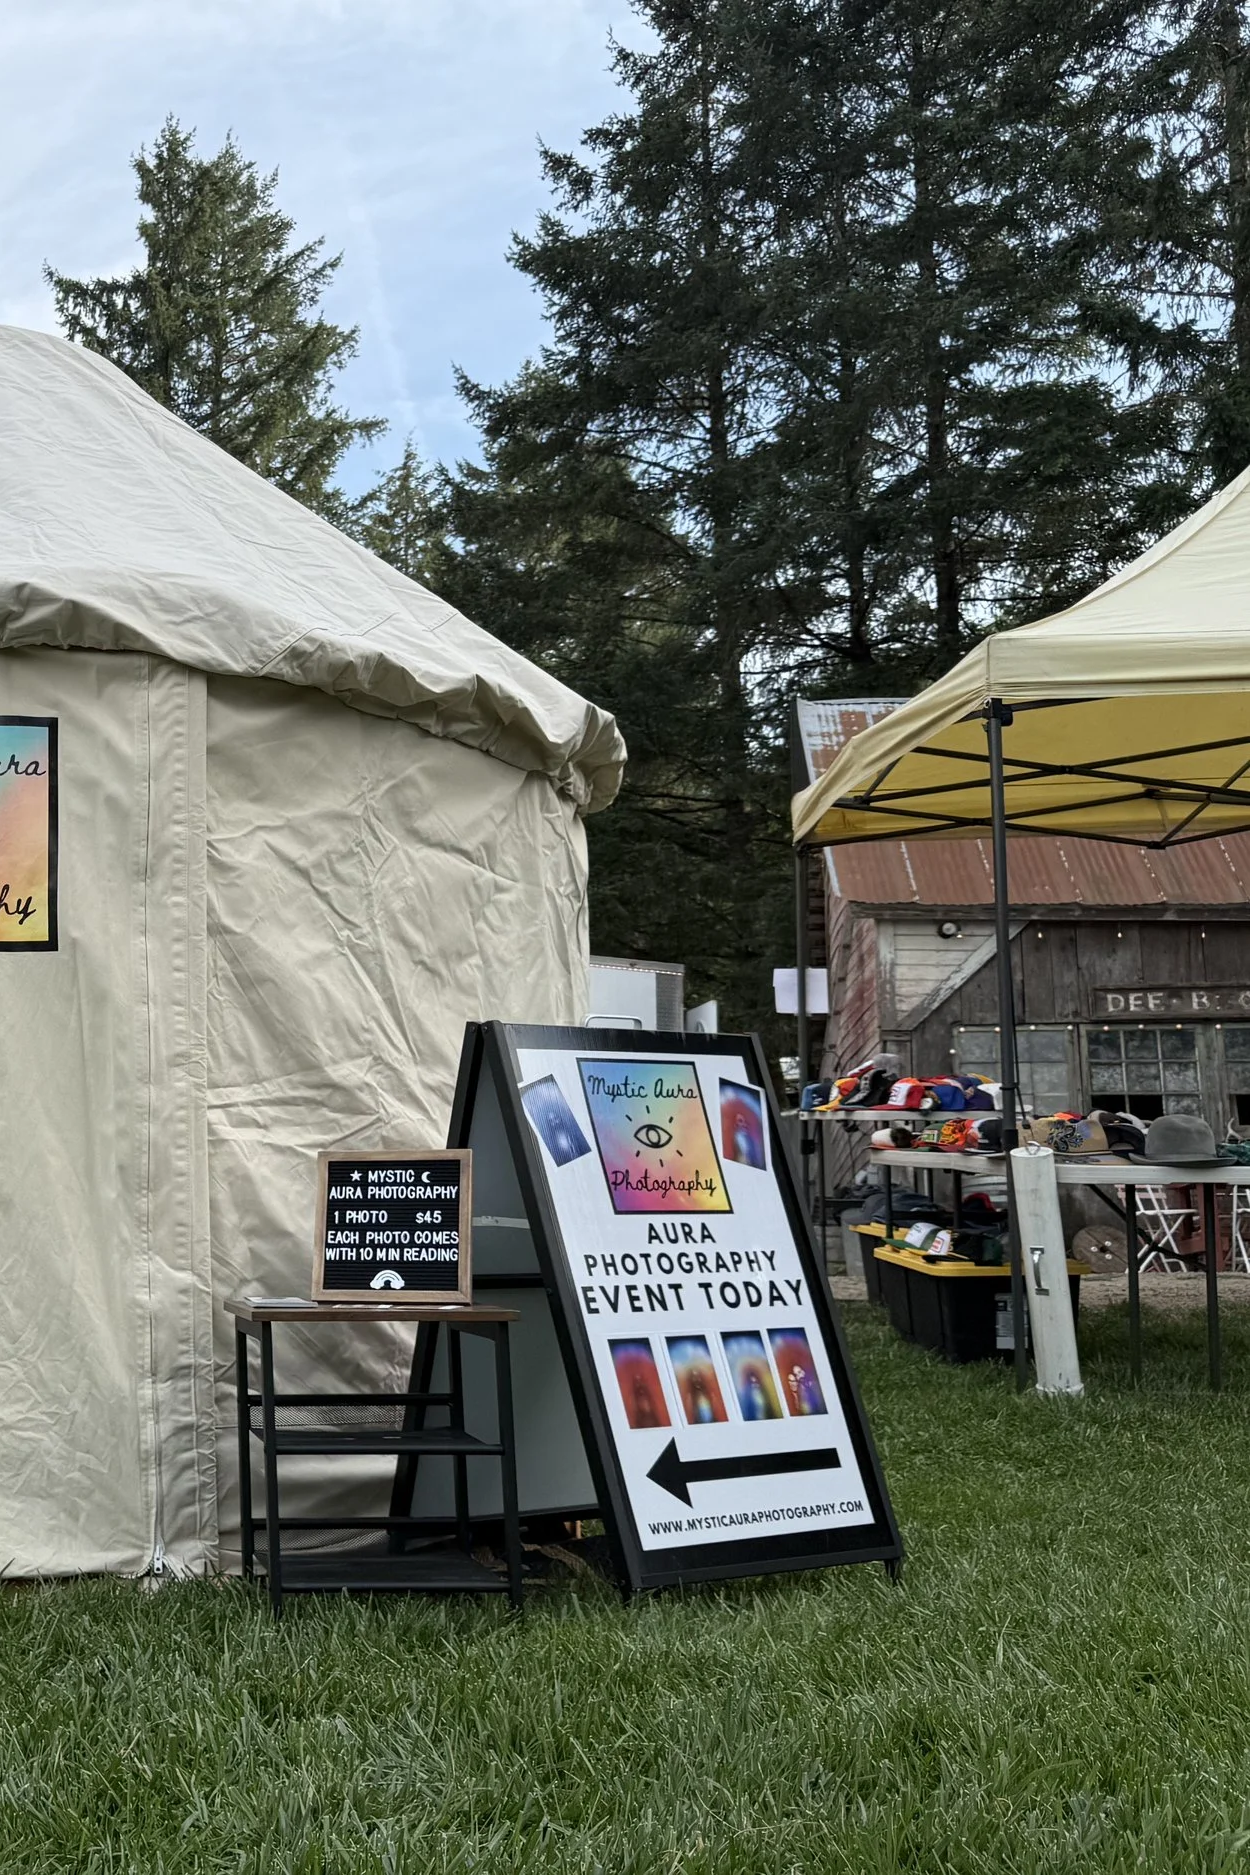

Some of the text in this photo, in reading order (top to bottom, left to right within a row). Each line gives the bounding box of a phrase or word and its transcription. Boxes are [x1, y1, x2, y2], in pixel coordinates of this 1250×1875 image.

[1107, 991, 1165, 1012] DEE
[587, 1075, 698, 1103] Mystic Aura
[367, 1169, 415, 1183] MYSTIC
[610, 1169, 717, 1199] Photography
[329, 1185, 458, 1200] AURA PHOTOGRAPHY
[334, 1210, 339, 1225] 1
[345, 1210, 388, 1224] PHOTO
[327, 1230, 460, 1245] EACH PHOTO COMES
[647, 1222, 716, 1245] AURA
[325, 1247, 459, 1262] WITH 10 MIN READING
[584, 1249, 777, 1277] PHOTOGRAPHY
[581, 1279, 804, 1315] EVENT TODAY
[647, 1500, 864, 1535] WWW.MYSTICAURAPHOTOGRAPHY.COM
